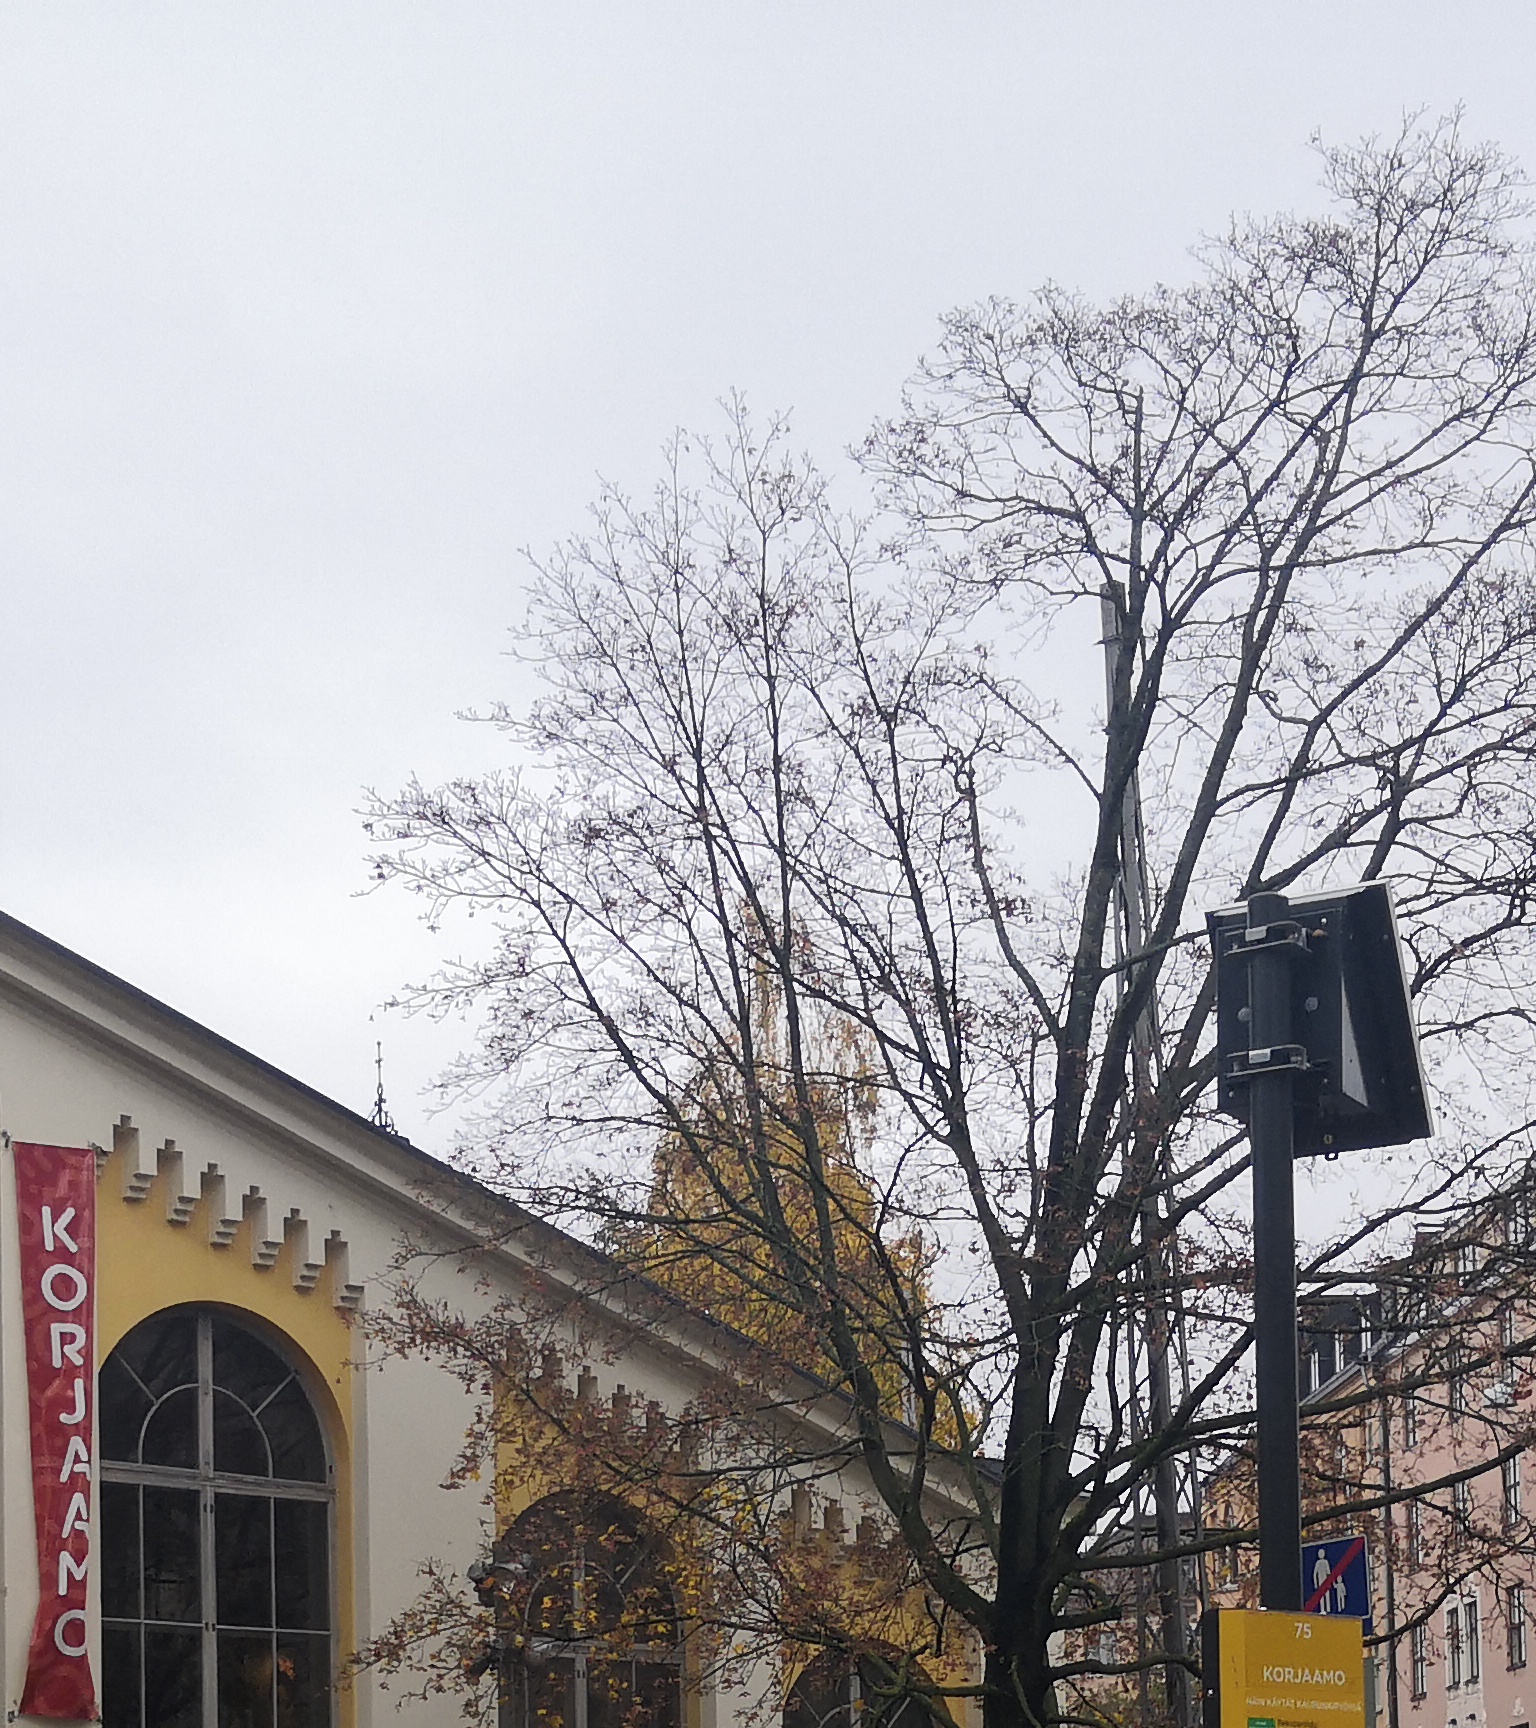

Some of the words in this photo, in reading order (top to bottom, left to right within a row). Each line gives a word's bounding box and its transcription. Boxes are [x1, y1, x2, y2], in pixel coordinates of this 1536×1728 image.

[40, 1205, 92, 1658] KORJAAMO
[1294, 1622, 1313, 1639] 75
[1263, 1665, 1346, 1686] KORJAAMO
